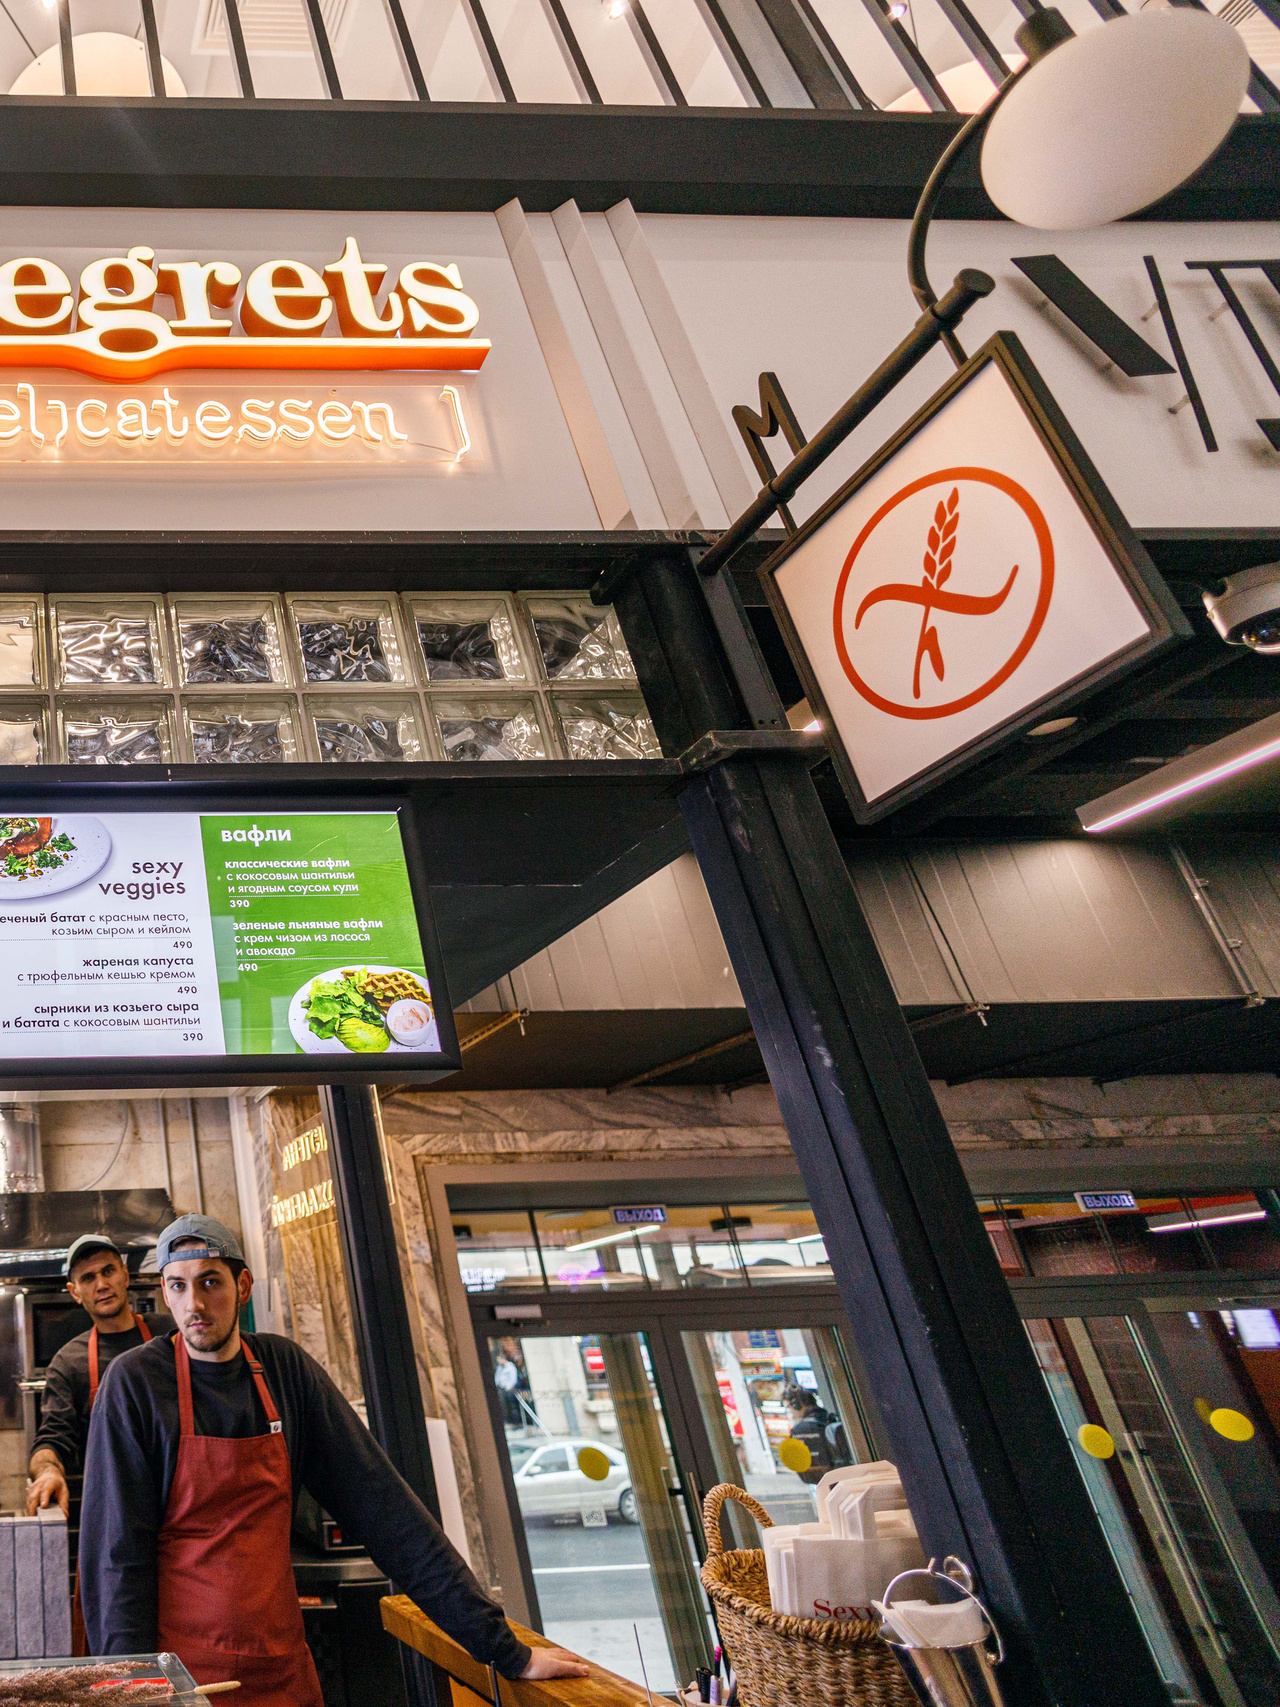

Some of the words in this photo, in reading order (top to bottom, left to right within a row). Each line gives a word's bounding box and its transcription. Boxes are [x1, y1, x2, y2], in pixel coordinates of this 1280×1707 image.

[221, 824, 291, 847] вафли
[225, 858, 308, 868] классические
[311, 857, 349, 870] вафли
[132, 861, 183, 880] sexy
[98, 879, 186, 900] veggies
[230, 900, 250, 908] 390
[50, 912, 85, 923] батат
[99, 914, 150, 924] красным
[153, 913, 189, 924] песто,
[233, 921, 285, 930] зеленые
[288, 920, 340, 929] льняные
[343, 918, 382, 931] вафли
[173, 941, 193, 949] 490
[83, 958, 139, 969] жареная
[143, 956, 194, 968] капуста
[238, 963, 258, 972] 490
[177, 986, 197, 994] 490
[34, 1004, 90, 1016] сырники
[94, 1004, 108, 1013] из
[114, 1003, 163, 1013] козьего
[167, 1003, 199, 1014] сыра
[183, 1033, 203, 1041] 390
[1083, 1194, 1132, 1207] ВЫХОД
[616, 1208, 666, 1222] ВЫХОД
